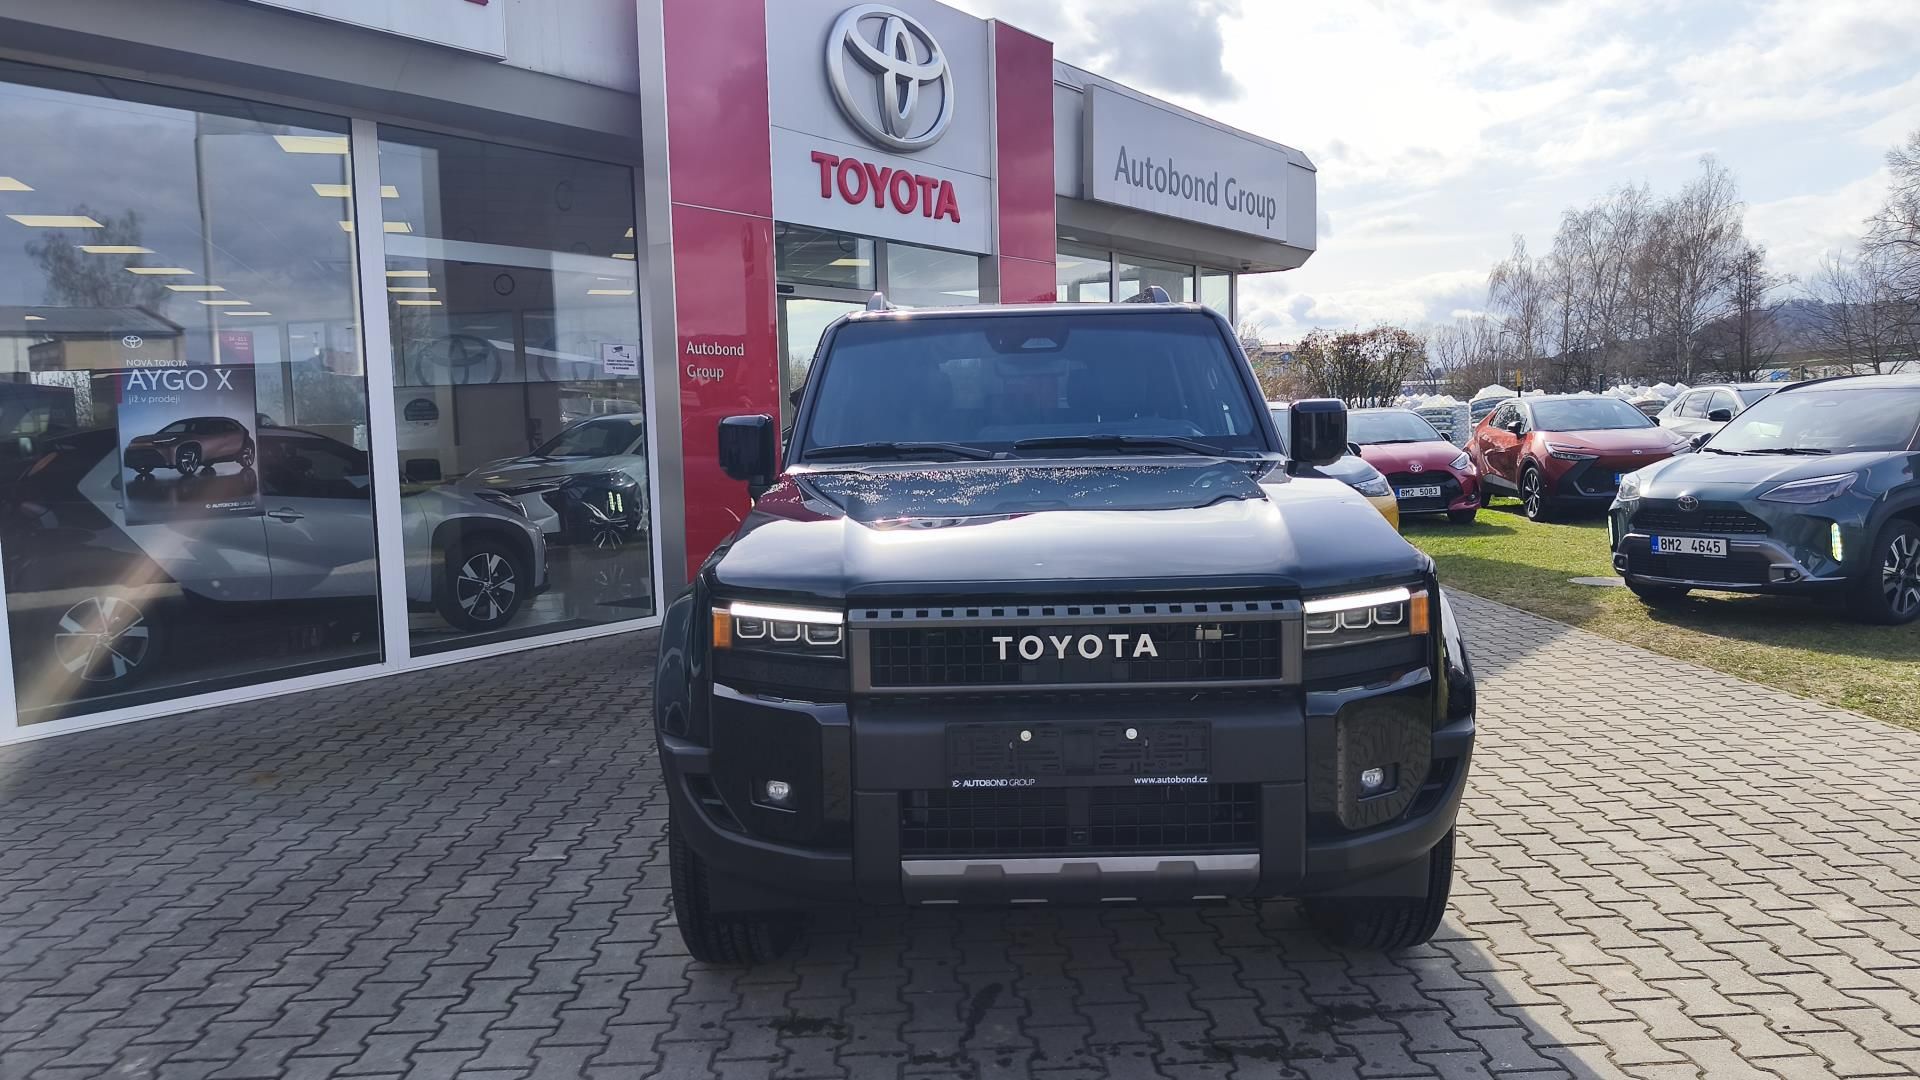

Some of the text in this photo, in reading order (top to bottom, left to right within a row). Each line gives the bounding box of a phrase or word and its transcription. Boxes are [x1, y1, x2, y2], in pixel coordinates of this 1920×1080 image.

[811, 150, 961, 223] TOYOTA
[1114, 145, 1276, 229] Autobond Group
[685, 341, 744, 356] Autobond
[154, 359, 188, 368] TOYOTA
[126, 368, 234, 391] AYGO X
[686, 364, 724, 382] Group
[148, 394, 181, 405] prodeji
[1400, 487, 1438, 497] 8M2 5083
[1660, 538, 1682, 552] 8M2
[1691, 539, 1721, 554] 4645
[992, 633, 1159, 661] TOYOTA
[962, 778, 1036, 787] AUTOBOND GROUP
[1134, 775, 1209, 784] www.autobond.cz
